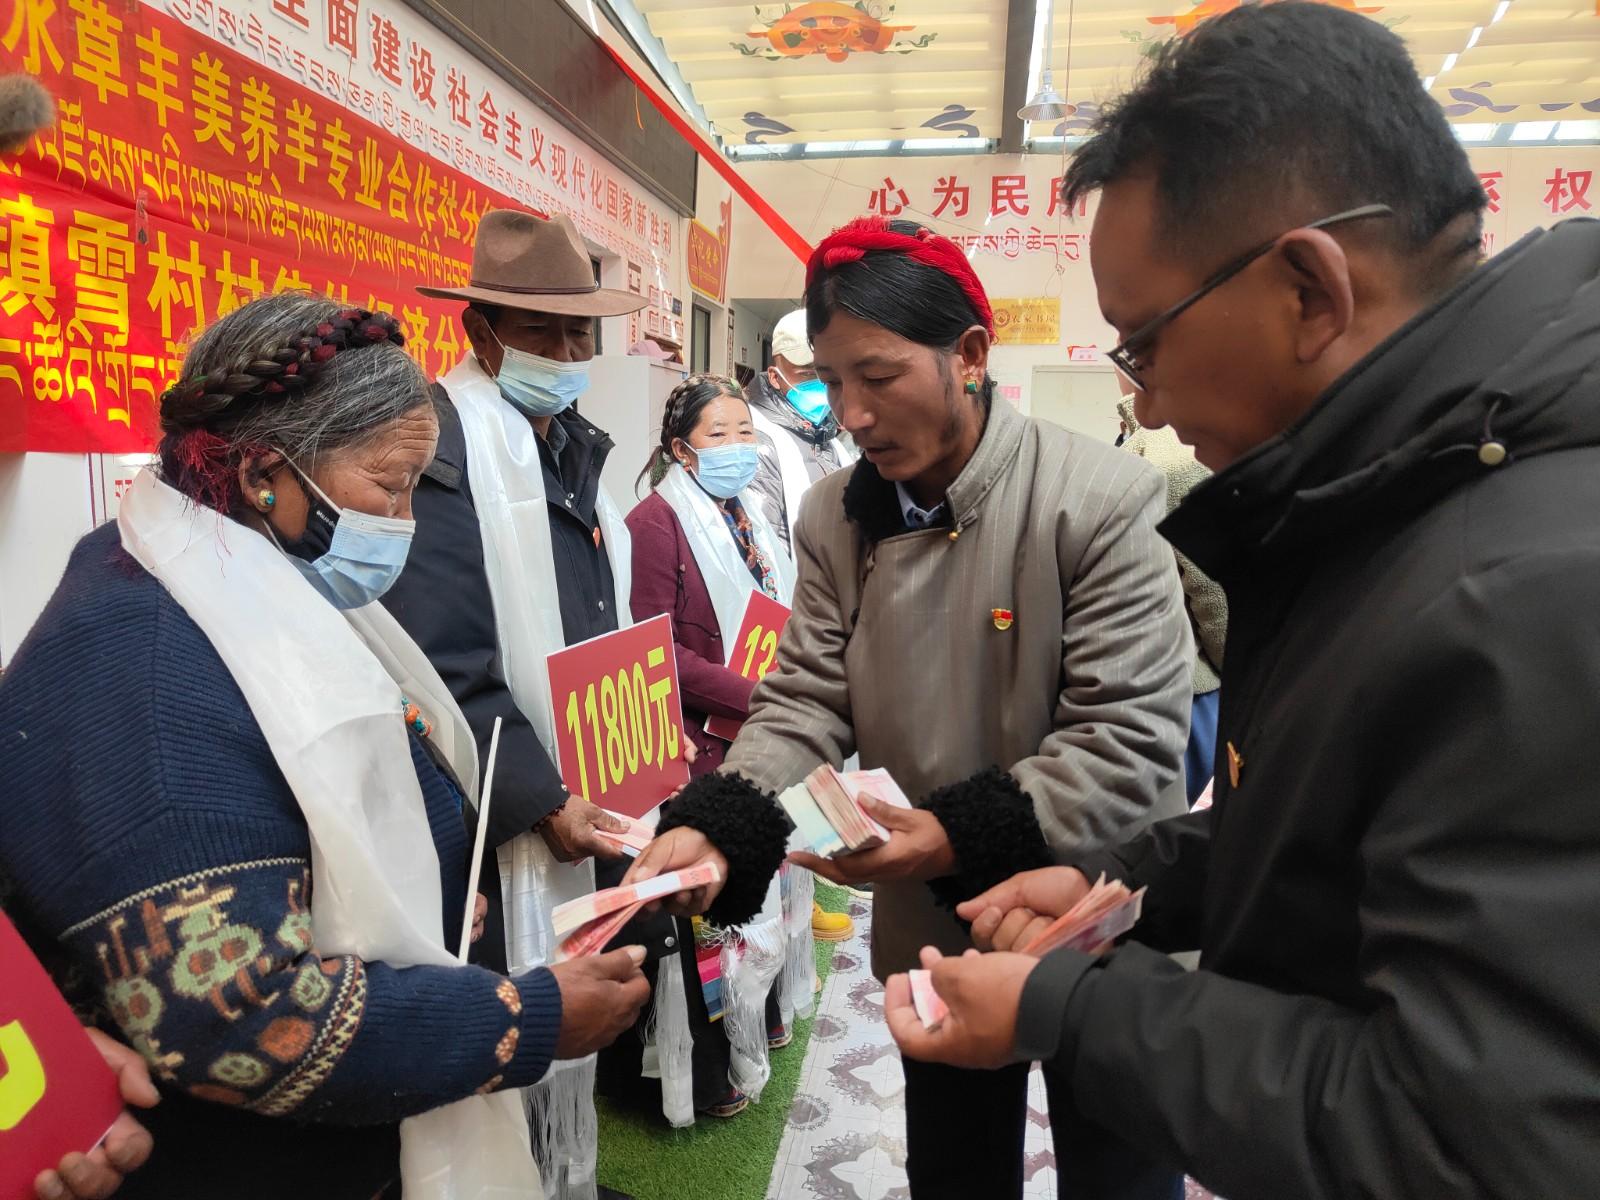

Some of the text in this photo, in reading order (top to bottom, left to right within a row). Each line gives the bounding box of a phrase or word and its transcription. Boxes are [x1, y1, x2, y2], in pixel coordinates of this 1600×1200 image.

[1, 0, 496, 247] 水草丰美养羊专业合作社分
[566, 646, 678, 801] 11800元
